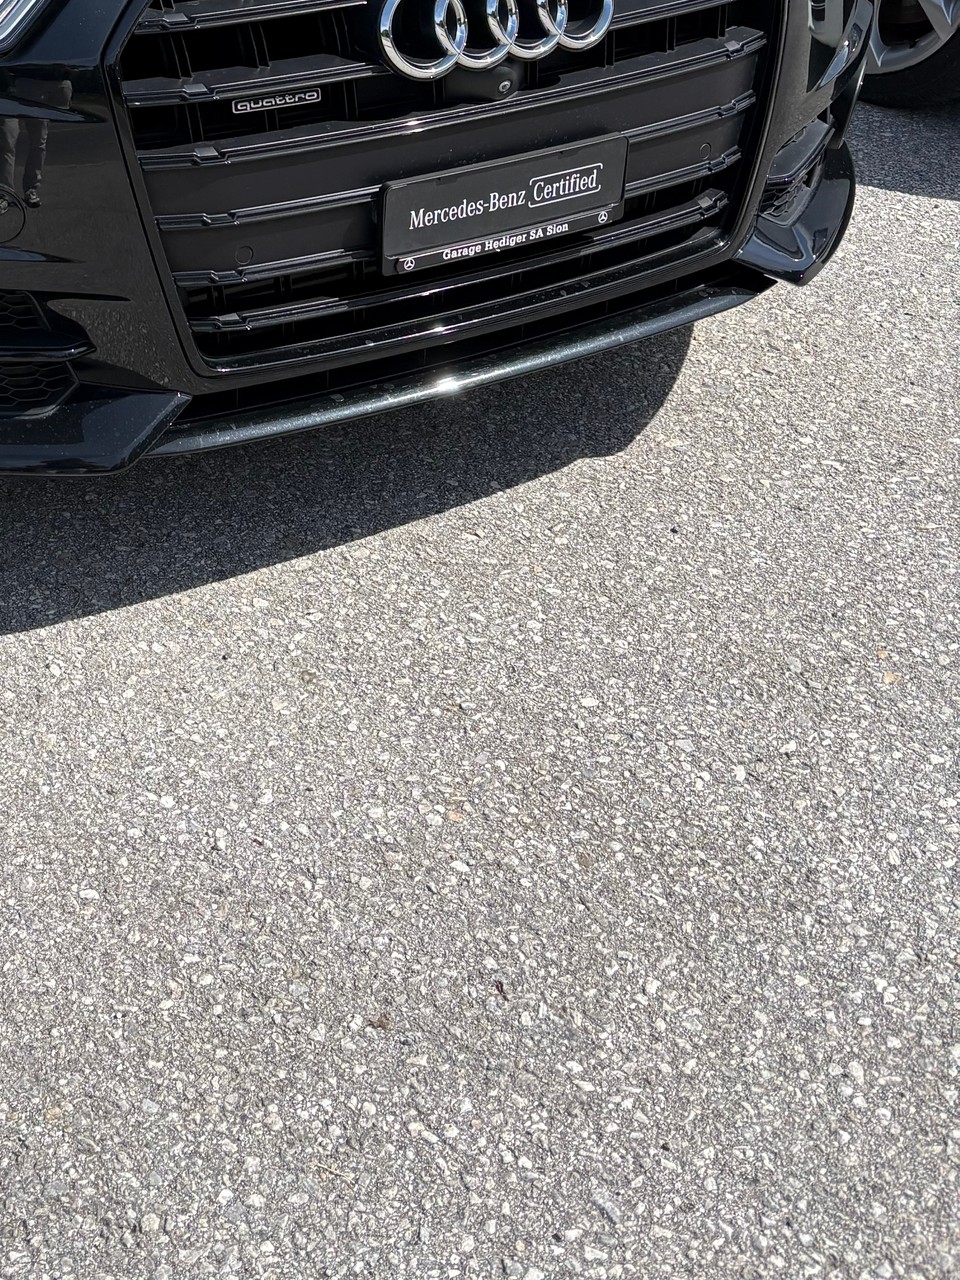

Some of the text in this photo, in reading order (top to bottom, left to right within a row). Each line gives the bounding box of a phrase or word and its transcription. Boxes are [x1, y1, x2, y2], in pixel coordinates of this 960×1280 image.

[237, 91, 318, 111] quattro
[408, 168, 597, 230] Mercedes-Benz Certified
[442, 223, 569, 260] Garage Hediger SA Sion
